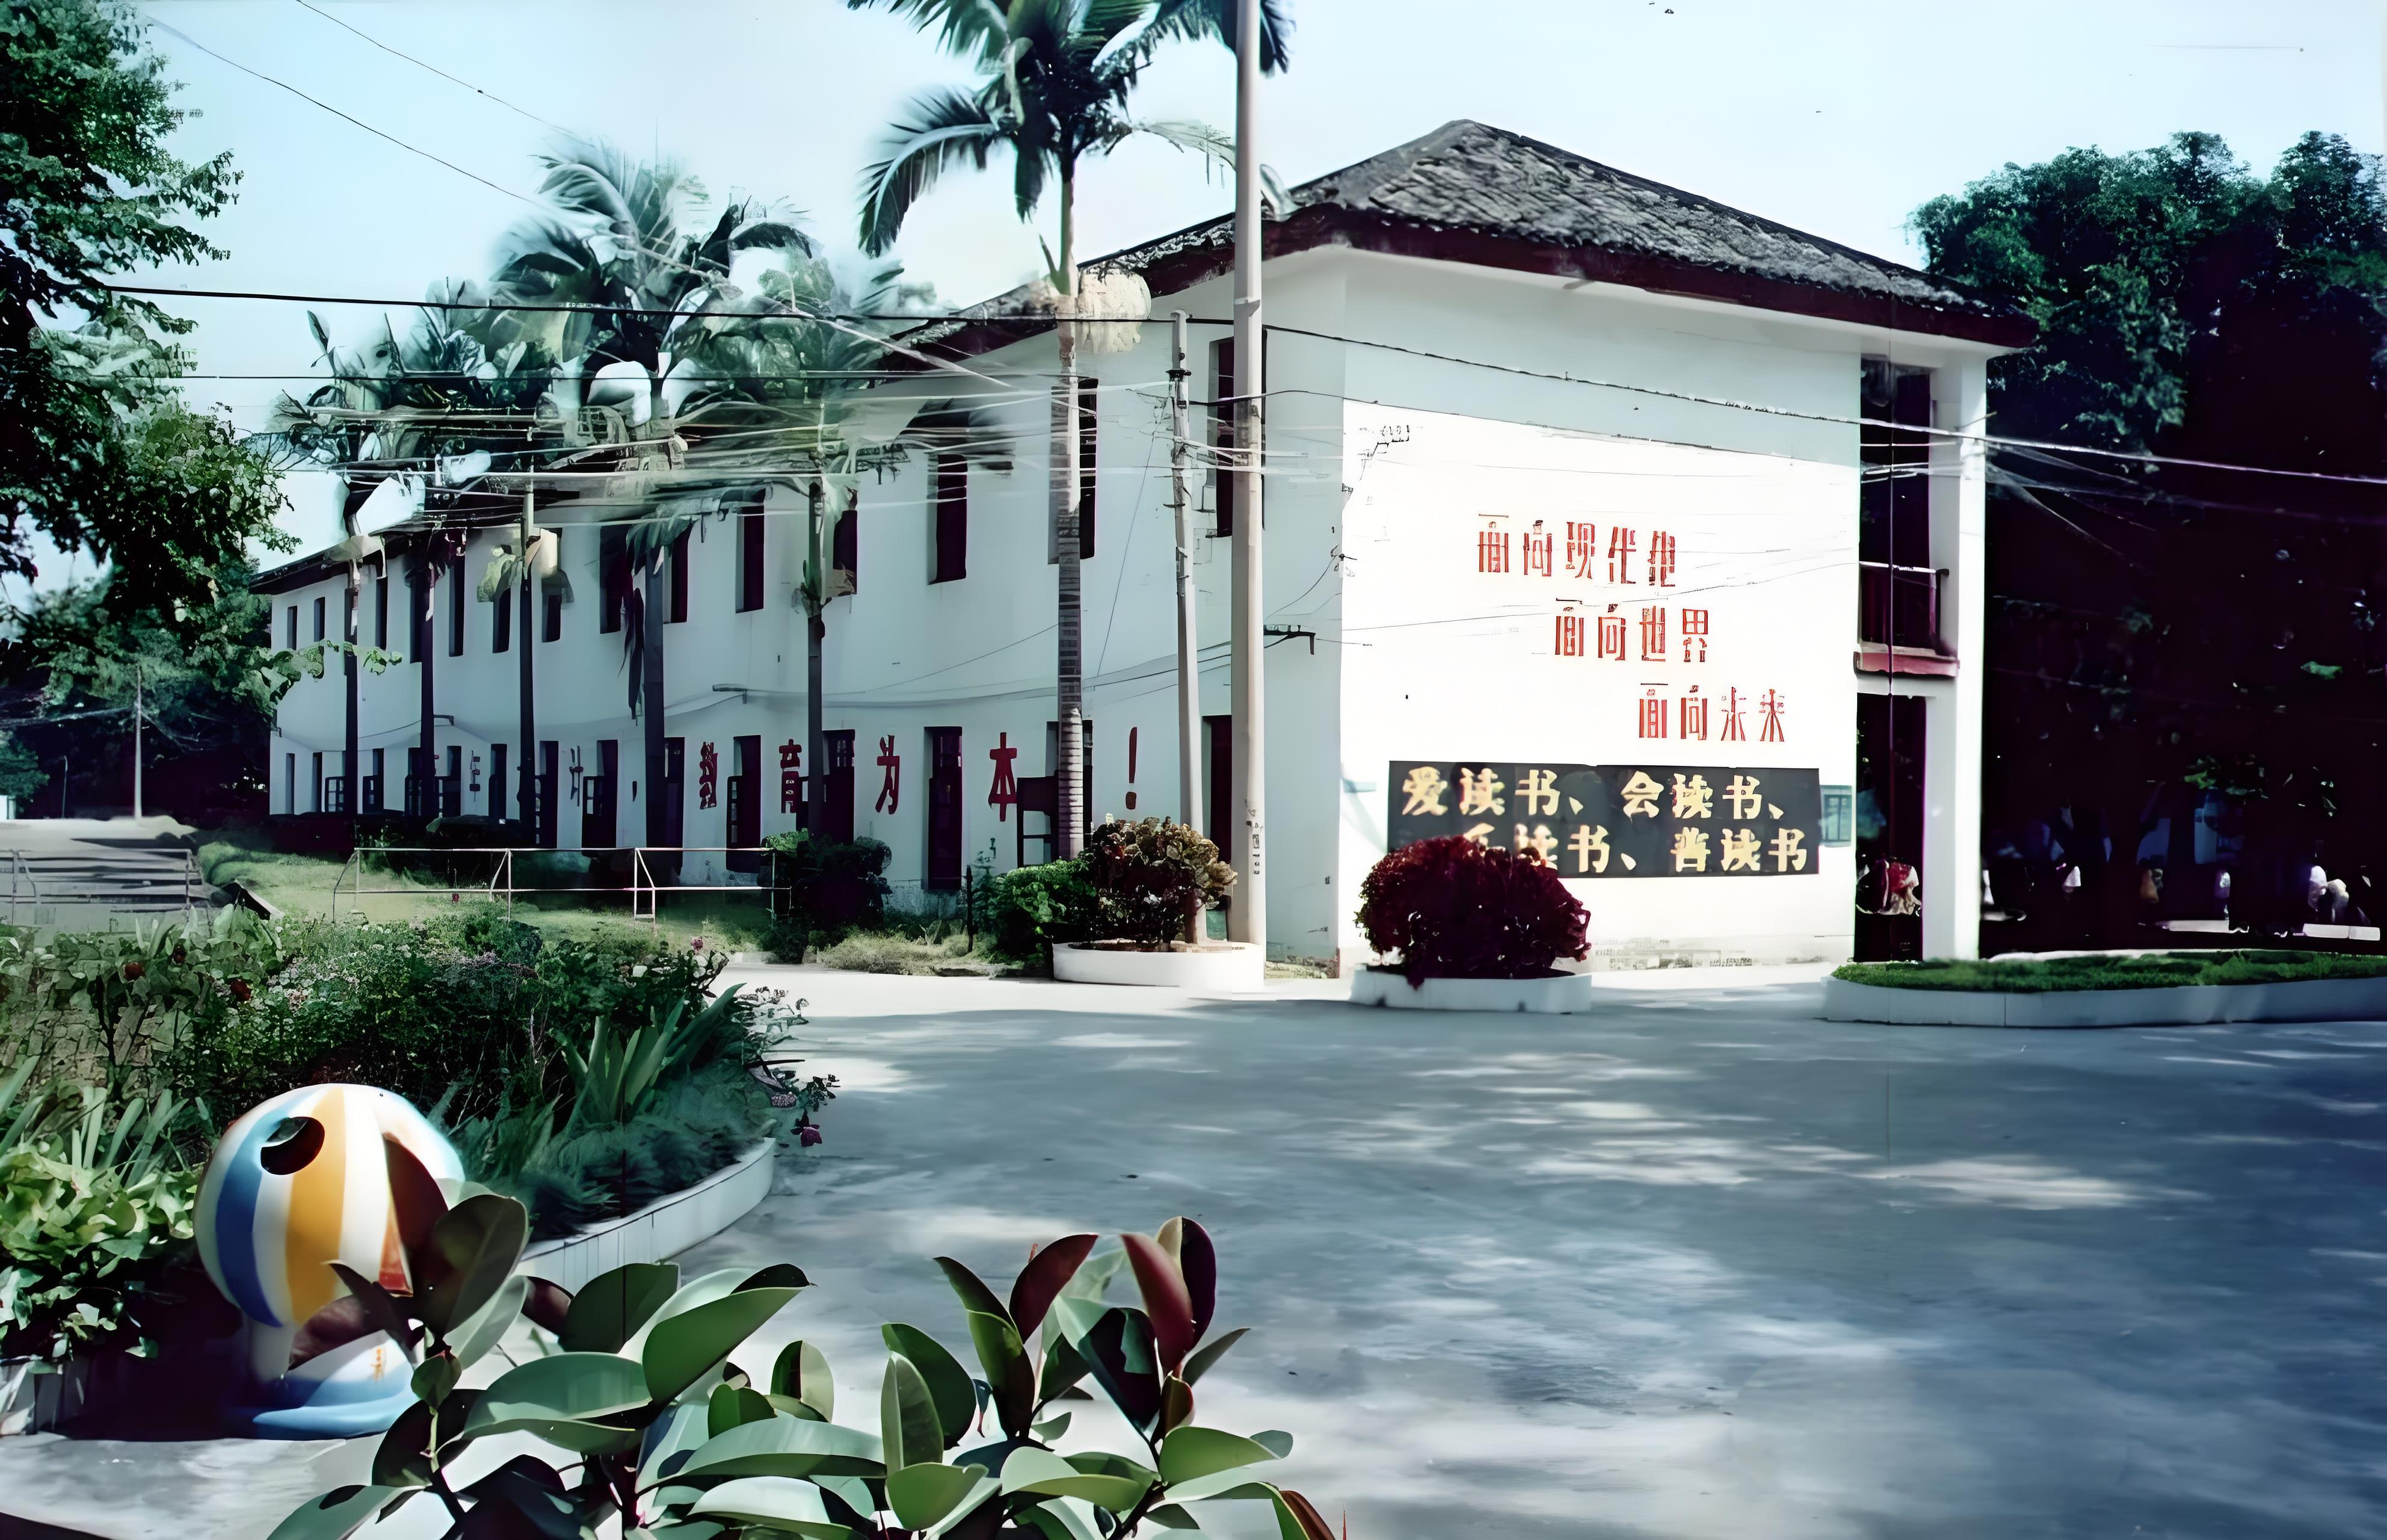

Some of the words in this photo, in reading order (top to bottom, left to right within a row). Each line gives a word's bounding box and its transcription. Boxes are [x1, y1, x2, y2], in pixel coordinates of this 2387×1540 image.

[1554, 597, 1709, 662] 面向世界
[1638, 683, 1785, 742] 面向未来
